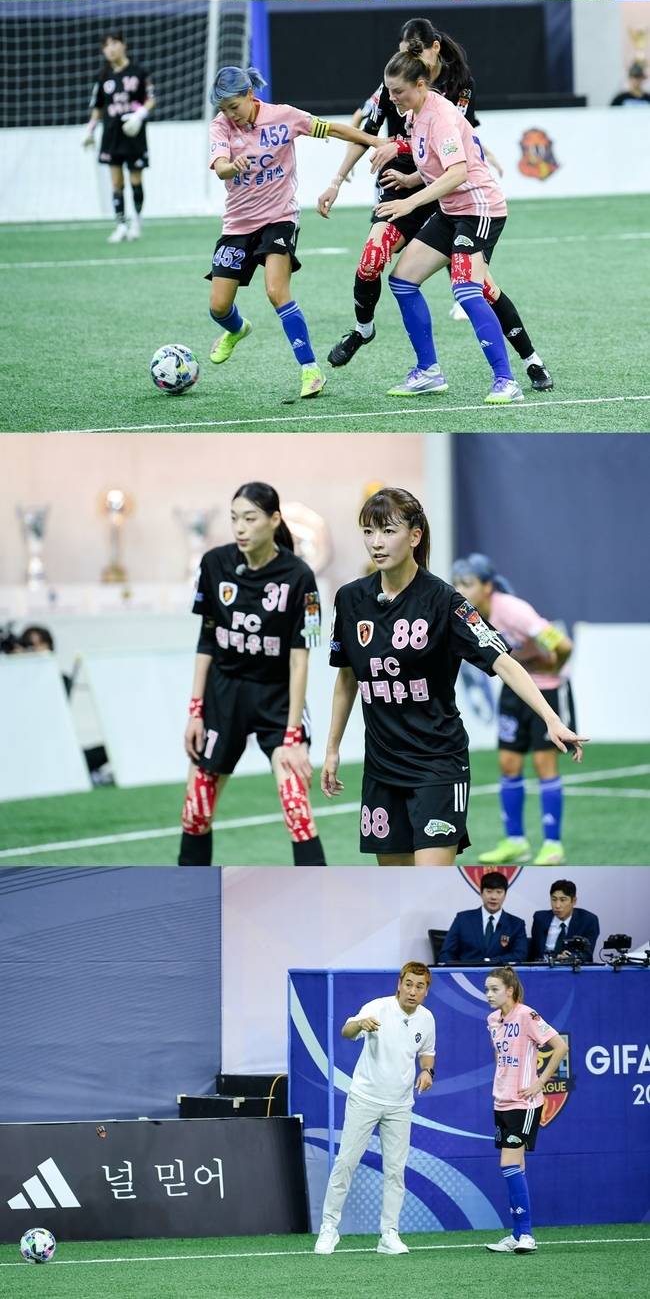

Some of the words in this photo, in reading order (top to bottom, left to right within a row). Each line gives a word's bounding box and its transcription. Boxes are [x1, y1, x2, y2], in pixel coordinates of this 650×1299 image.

[259, 123, 290, 147] 452
[417, 137, 426, 159] 5
[246, 153, 275, 170] FC
[212, 245, 246, 270] 452
[261, 581, 291, 613] 31
[231, 610, 263, 634] FC
[391, 618, 430, 650] 88
[370, 656, 401, 678] FC
[360, 804, 391, 839] 88
[503, 1022, 521, 1039] 720
[495, 1040, 510, 1053] FC
[541, 1081, 567, 1093] AGUE
[101, 1159, 137, 1200] 널
[154, 1157, 224, 1200] 믿어
